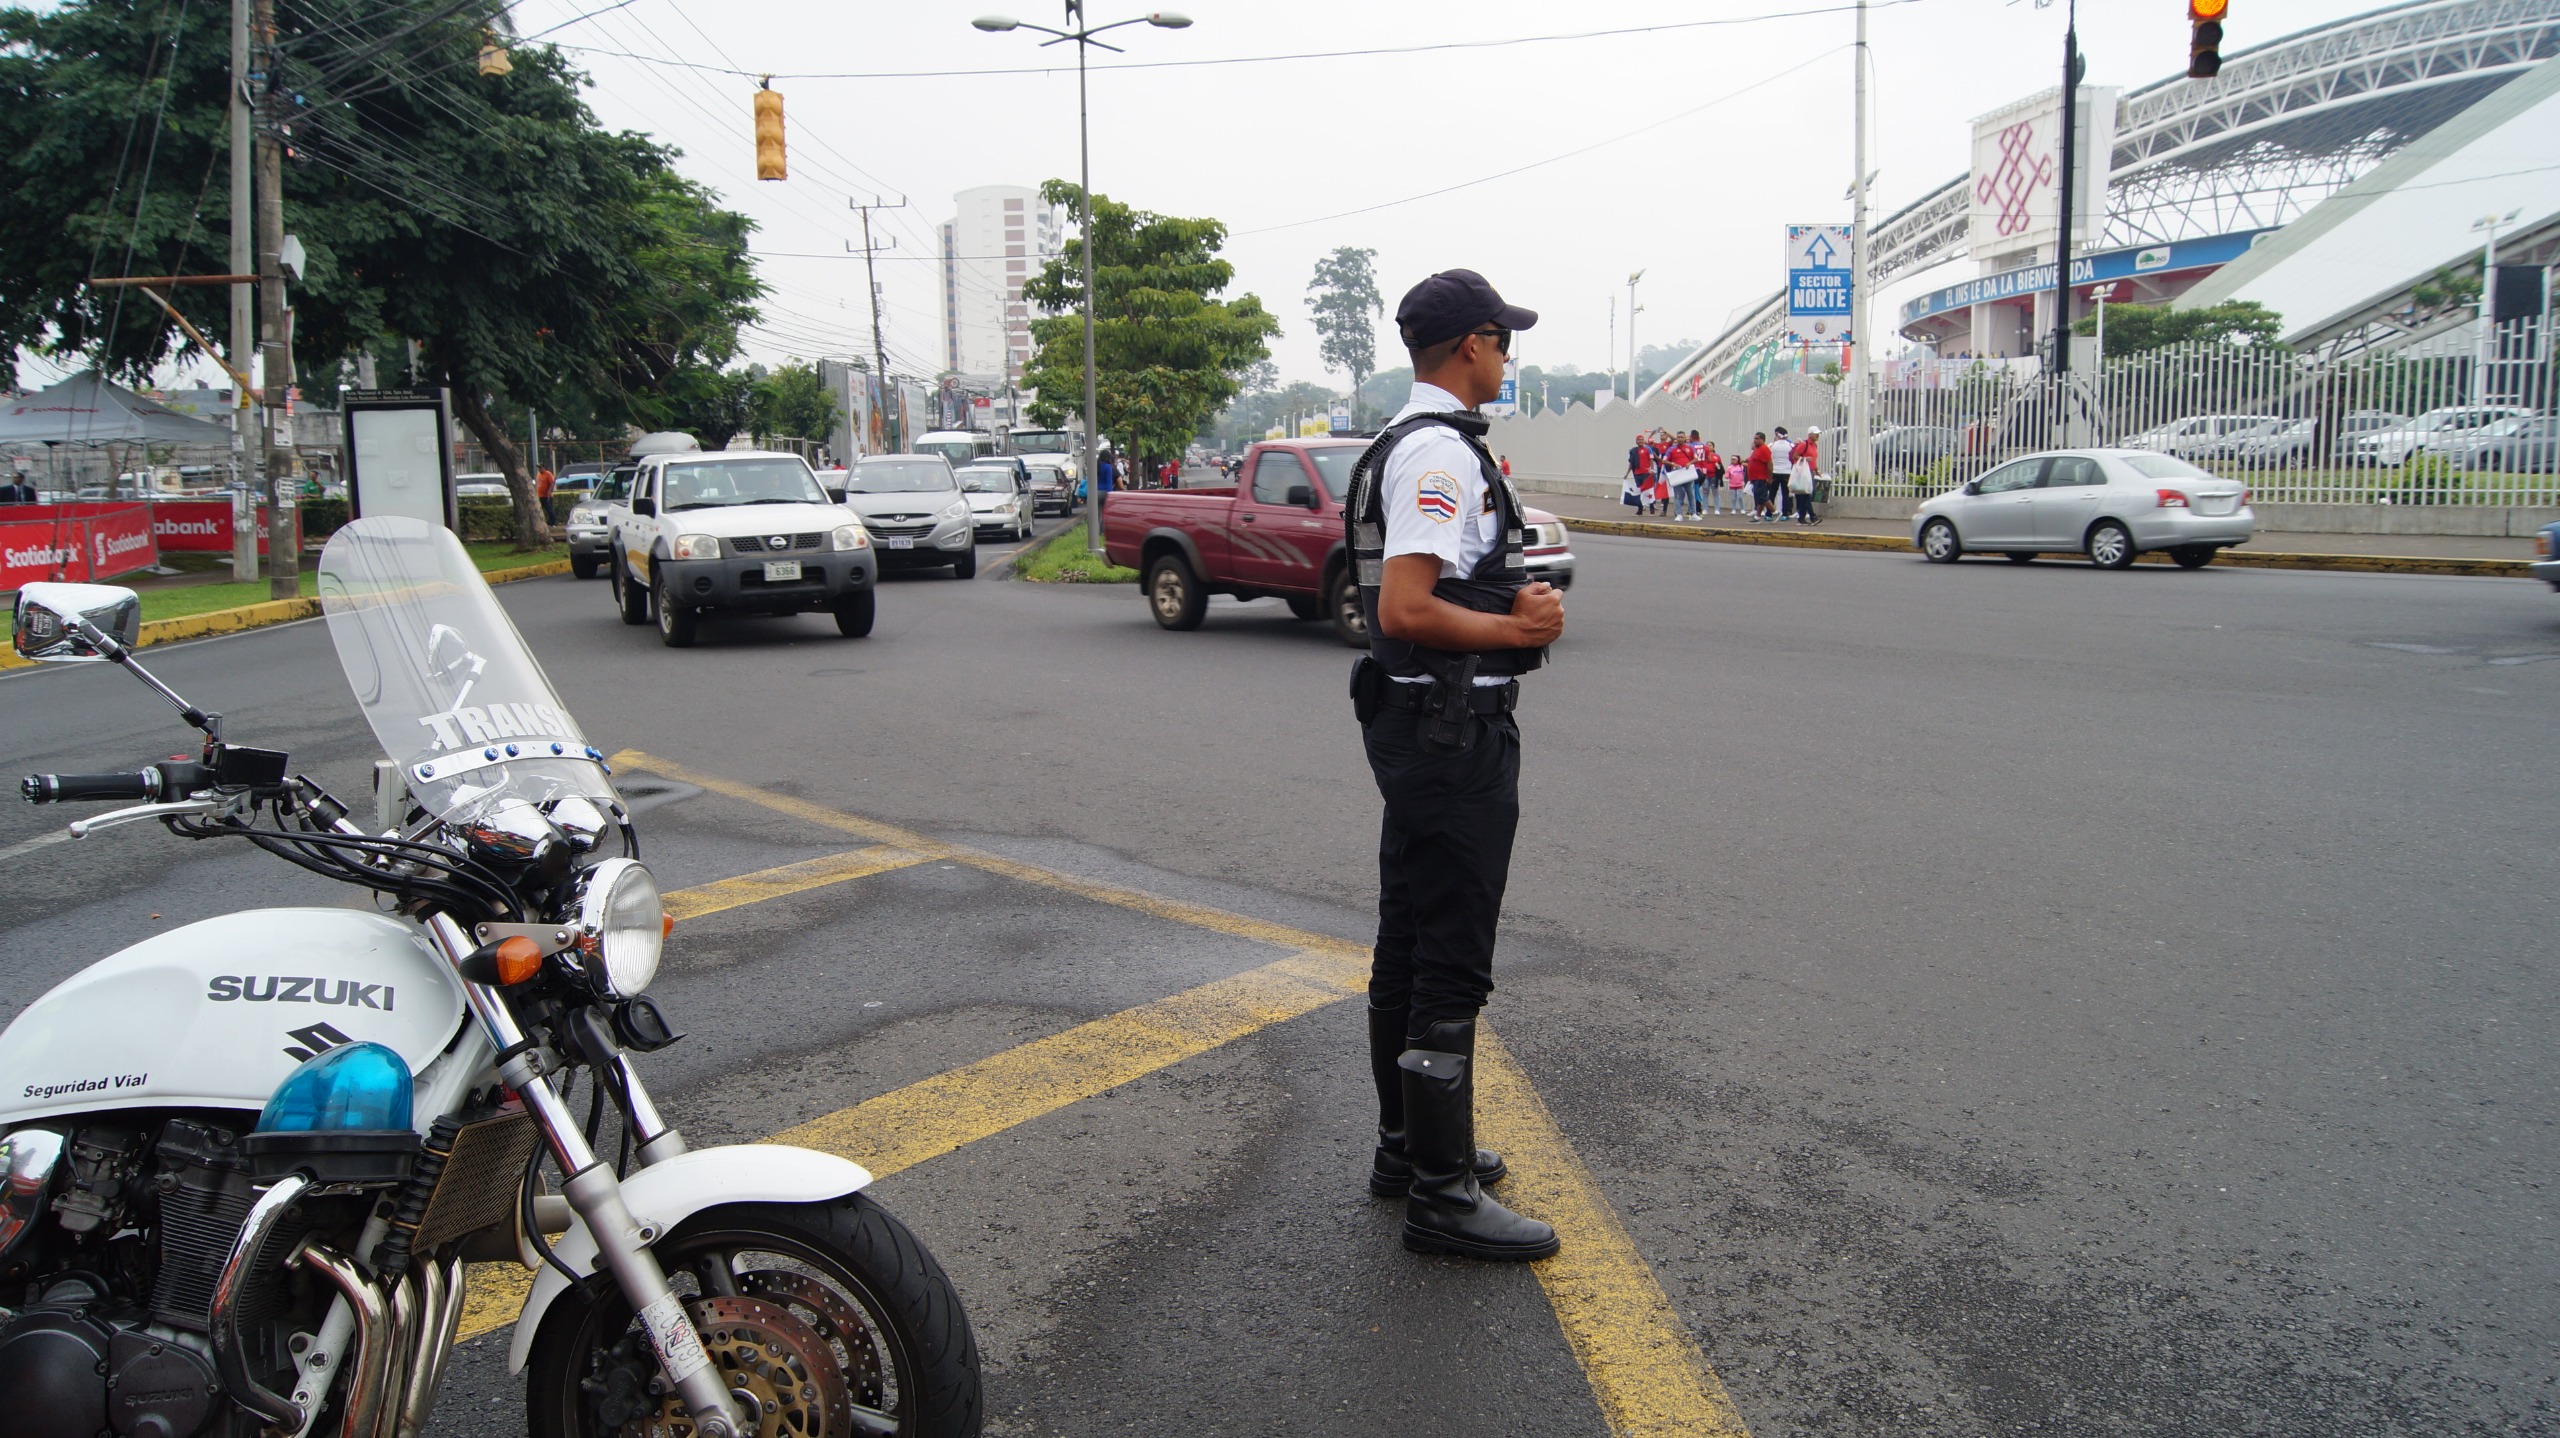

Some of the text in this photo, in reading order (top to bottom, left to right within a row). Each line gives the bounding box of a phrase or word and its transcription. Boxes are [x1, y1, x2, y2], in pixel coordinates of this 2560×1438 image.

[1799, 276, 1841, 287] SECTOR
[1946, 259, 2094, 307] EL INS LE DA LA BIENVEIDA
[1794, 289, 1847, 308] NORTE
[106, 529, 150, 556] Scotiabank
[207, 975, 394, 1011] SUZUKI
[23, 1073, 147, 1098] Seguridad Vial
[124, 1388, 193, 1405] SUZUKI
